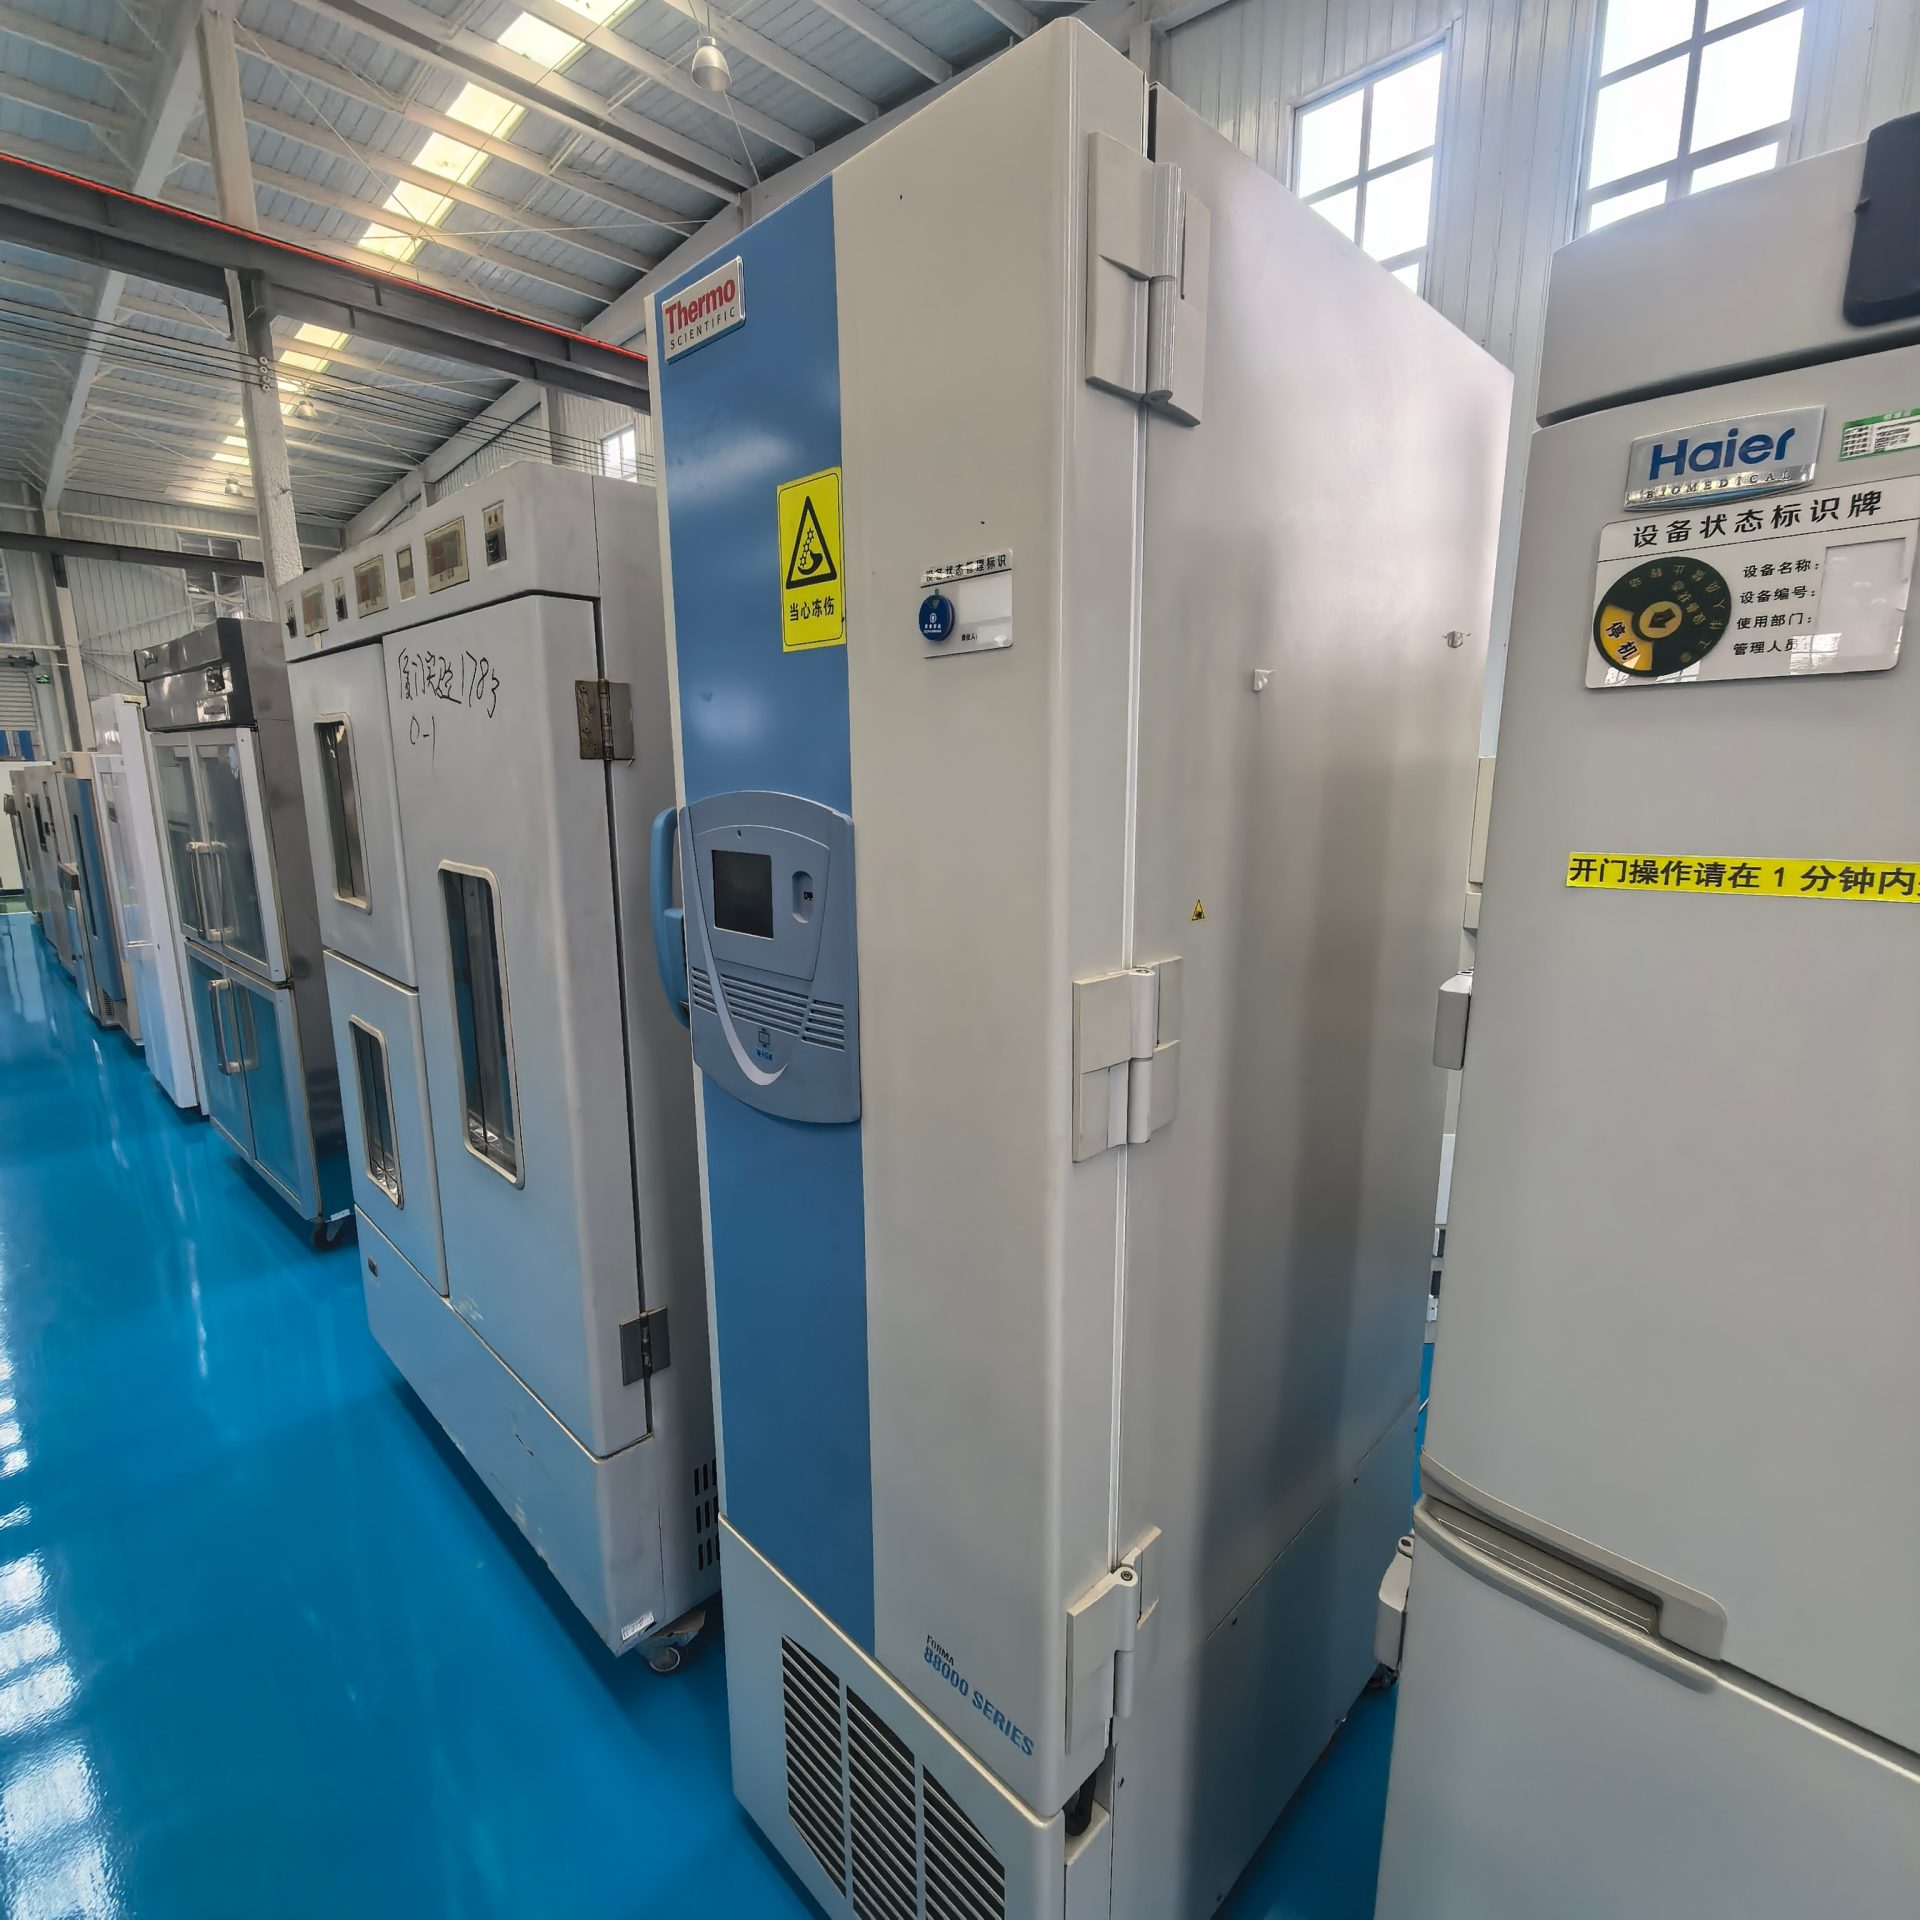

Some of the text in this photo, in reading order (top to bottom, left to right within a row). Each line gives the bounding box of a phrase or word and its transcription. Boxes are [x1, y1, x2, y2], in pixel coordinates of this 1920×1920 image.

[665, 279, 736, 335] Thermo
[670, 306, 736, 350] SCIENTIFIC
[1649, 428, 1795, 480] Haier
[1645, 470, 1793, 499] BIOMEDICAL
[1633, 490, 1882, 548] 设备状态标识牌
[1743, 559, 1820, 578] 设备名称：
[790, 596, 835, 621] 当心冻伤
[1740, 585, 1816, 604] 设备编号：
[1736, 612, 1812, 630] 使用部门：
[1605, 621, 1638, 660] 停机
[1800, 864, 1920, 896] 分钟内
[926, 1635, 954, 1666] FORMA
[924, 1646, 1034, 1756] 88000 SERIES
